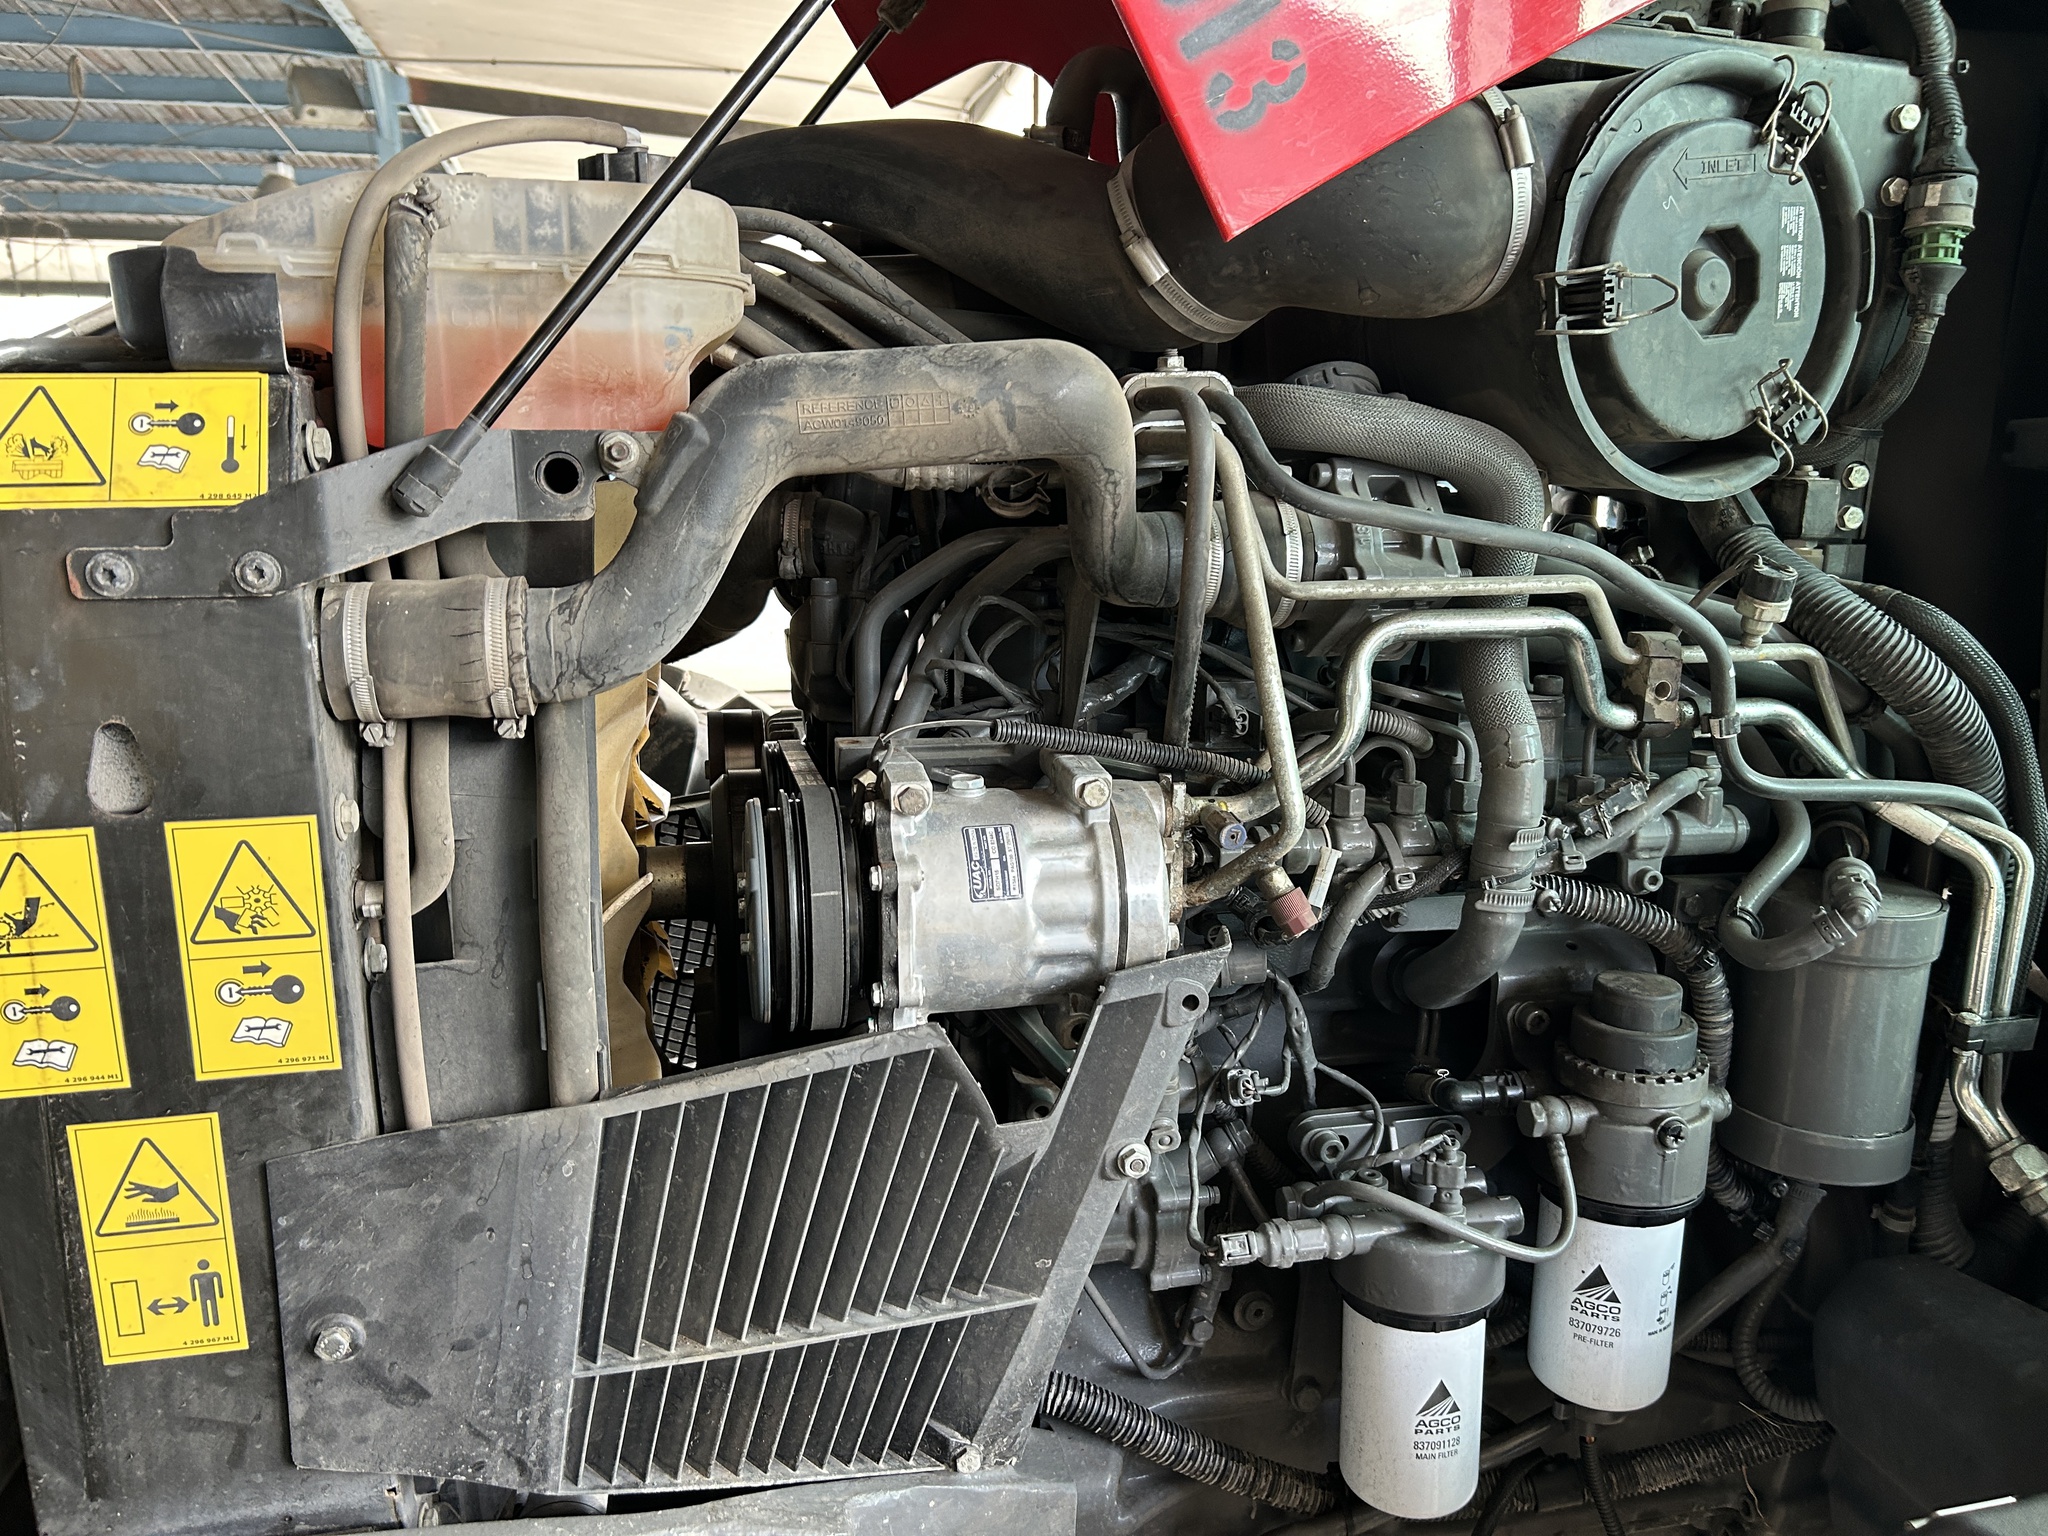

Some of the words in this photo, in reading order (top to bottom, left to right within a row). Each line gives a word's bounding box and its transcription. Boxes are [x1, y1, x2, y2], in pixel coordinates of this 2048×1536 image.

[1701, 158, 1742, 174] INLET
[1797, 206, 1805, 242] ATTENTION
[971, 860, 982, 890] UAC
[1570, 1304, 1620, 1322] PARTS
[1572, 1297, 1622, 1314] AGCO
[1568, 1316, 1622, 1338] 837079726
[1573, 1332, 1614, 1348] PRE-FILTER
[1414, 1424, 1460, 1435] PARTS
[1415, 1415, 1460, 1428] AGCO
[1414, 1436, 1460, 1450] 837091128
[1438, 1449, 1458, 1459] FILTER
